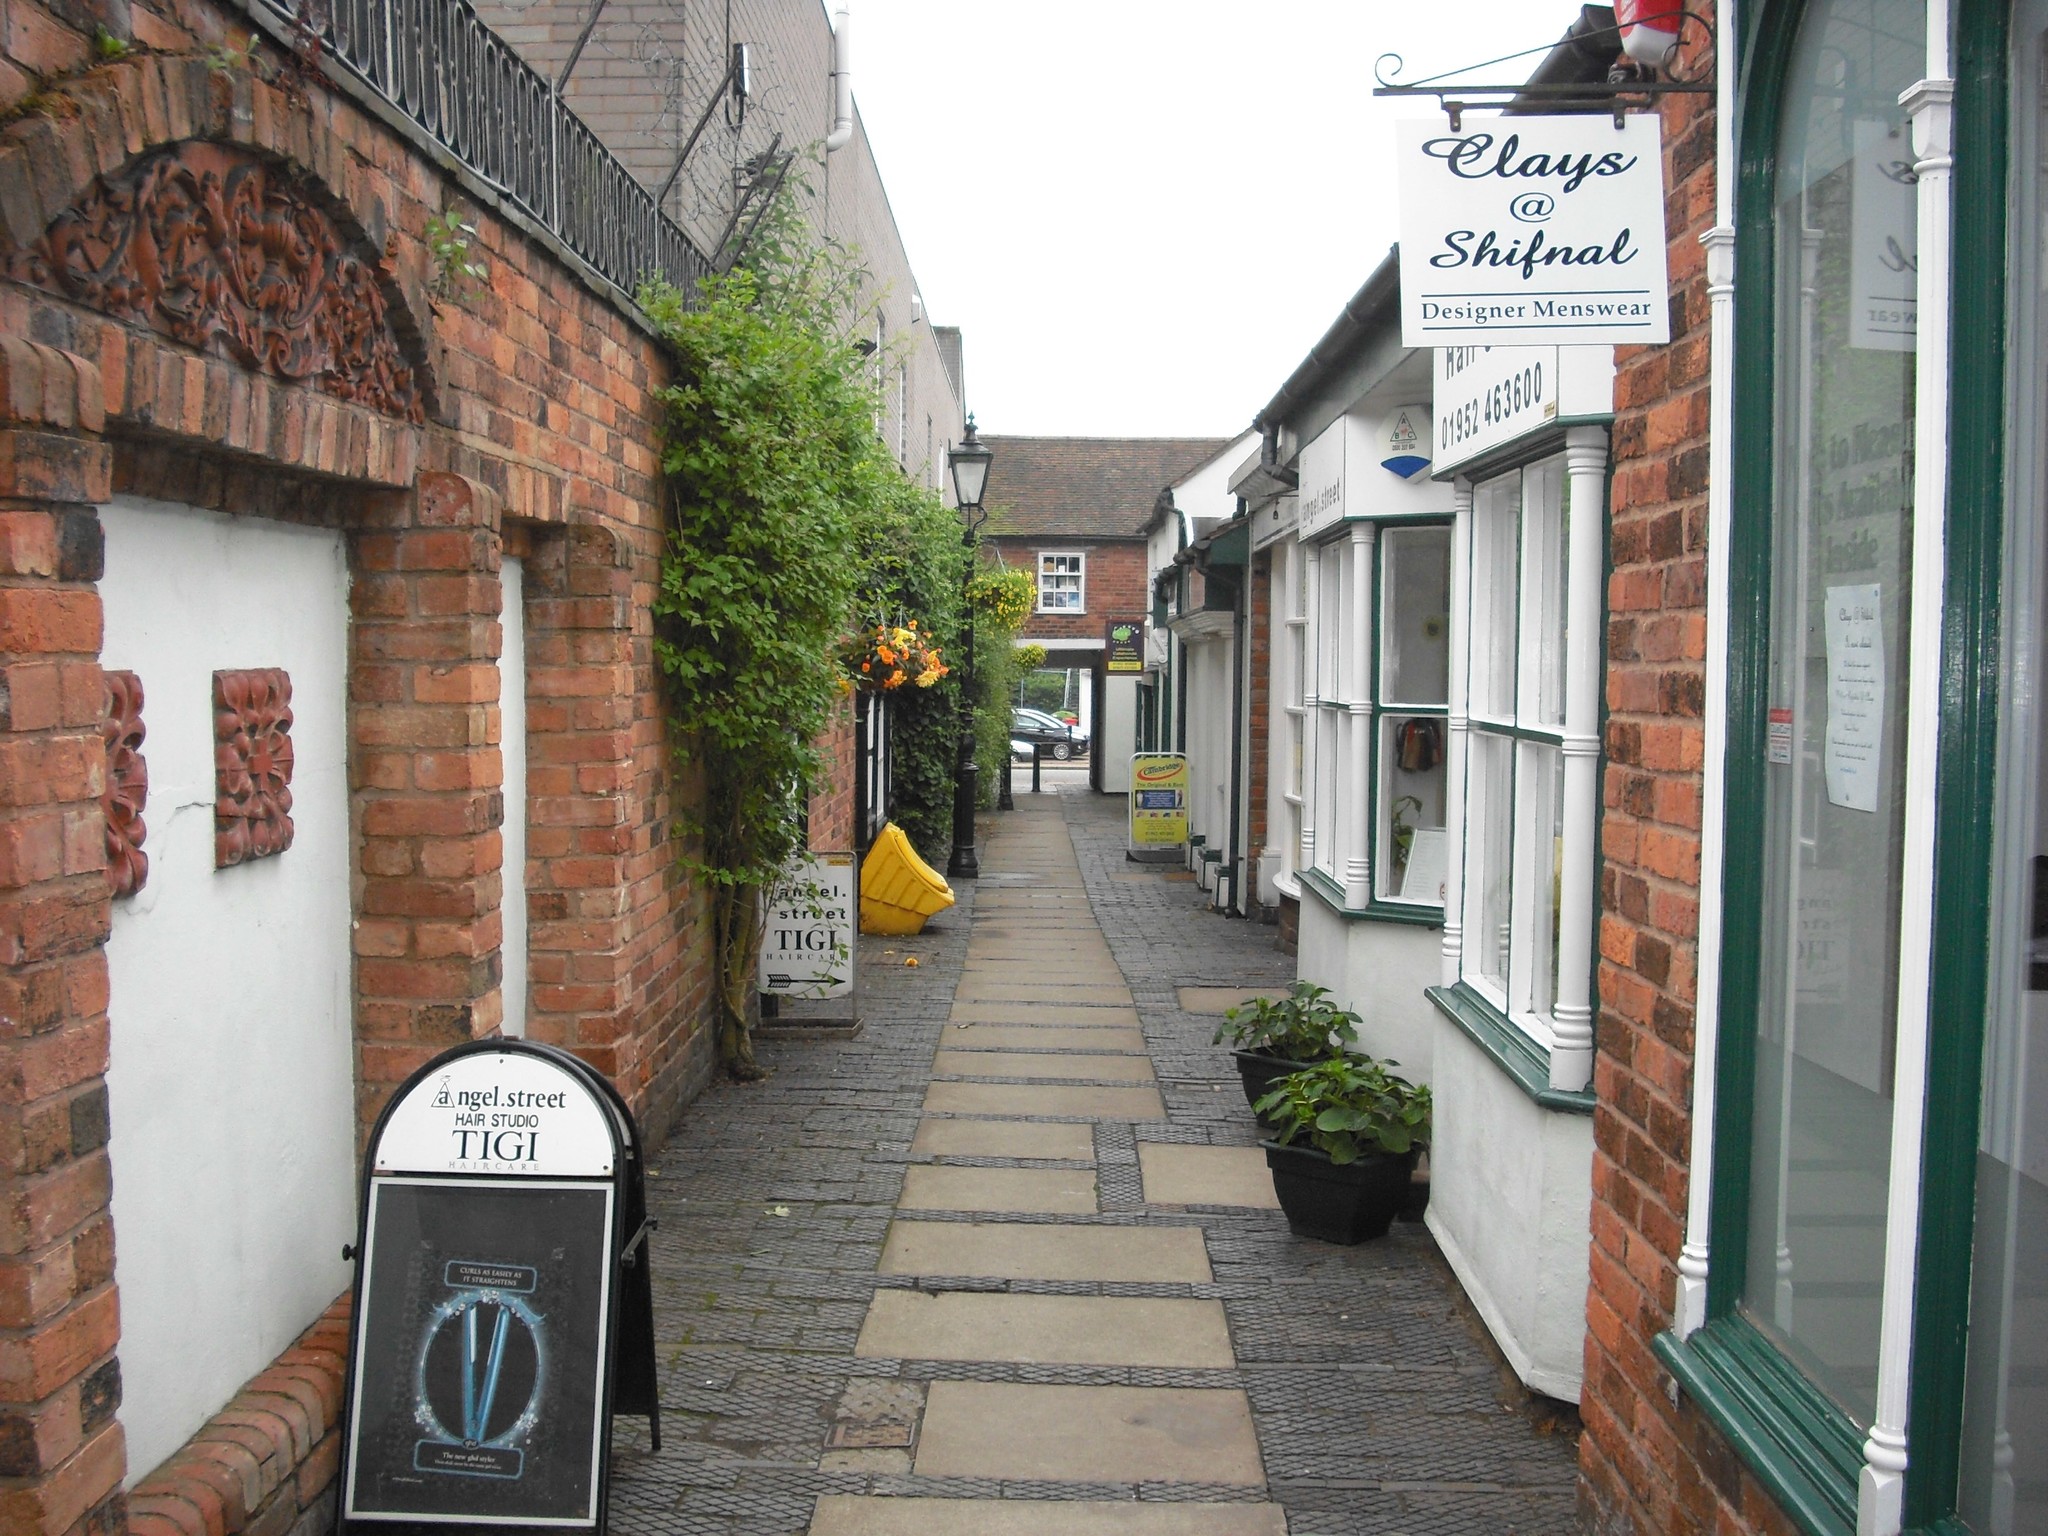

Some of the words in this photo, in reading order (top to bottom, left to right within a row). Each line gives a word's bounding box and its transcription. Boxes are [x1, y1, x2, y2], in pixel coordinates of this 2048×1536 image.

[1421, 133, 1638, 193] Clays
[1510, 192, 1555, 223] @
[1429, 228, 1639, 280] Shifnal
[1422, 301, 1525, 324] Designer
[1533, 299, 1651, 318] Menswear
[1442, 398, 1479, 450] 01952
[1484, 361, 1542, 427] 463600
[774, 930, 837, 951] TIGI
[766, 953, 848, 961] HAIRCAR
[455, 1113, 485, 1127] HAIR
[491, 1114, 539, 1128] STUDIO
[452, 1130, 540, 1162] TIGI
[449, 1161, 540, 1171] HAIRCARE
[471, 1277, 517, 1286] STRAIGHTENS
